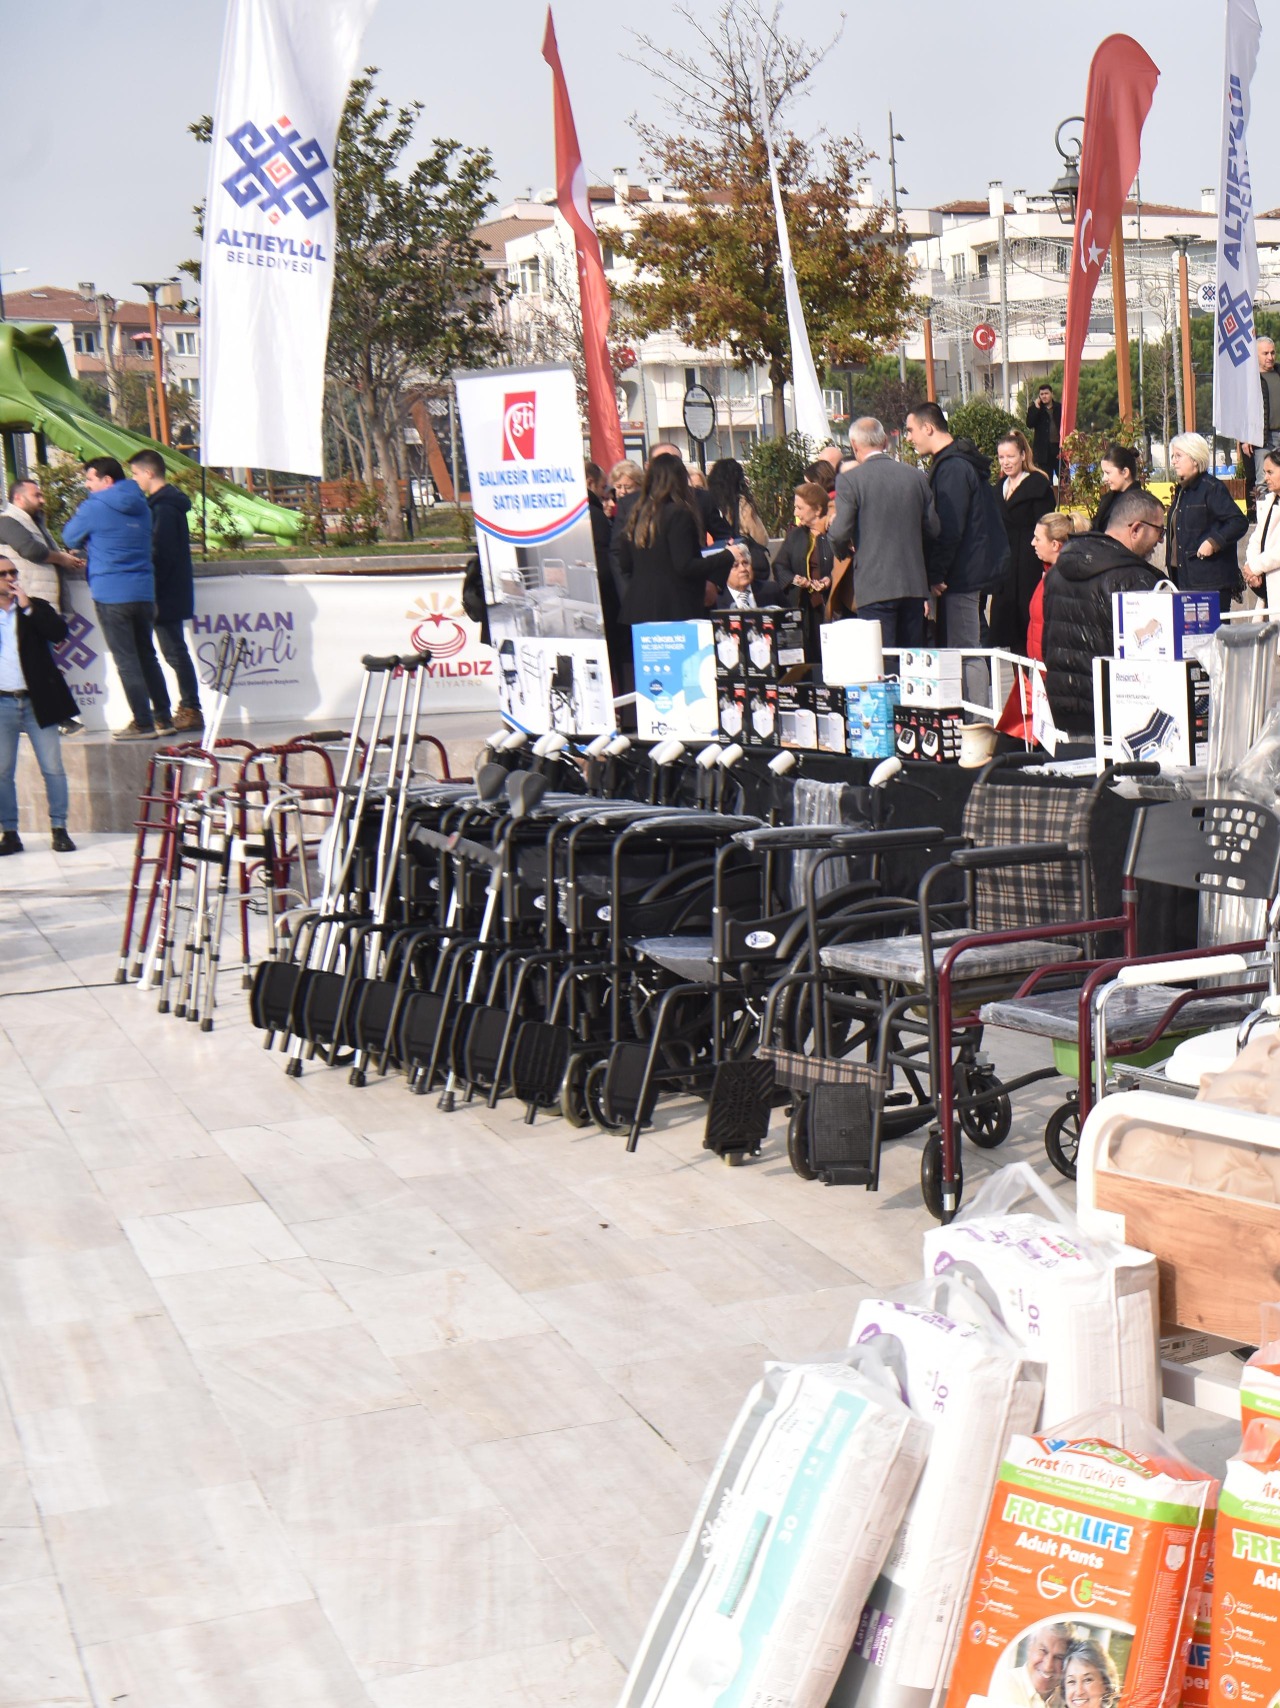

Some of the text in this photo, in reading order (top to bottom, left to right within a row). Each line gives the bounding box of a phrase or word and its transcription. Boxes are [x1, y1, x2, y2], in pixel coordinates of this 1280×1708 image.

[192, 611, 294, 634] HAKAN
[1002, 1494, 1134, 1555] FRESHLIFE
[1016, 1532, 1105, 1569] Adult Pants
[1078, 1579, 1093, 1602] 5
